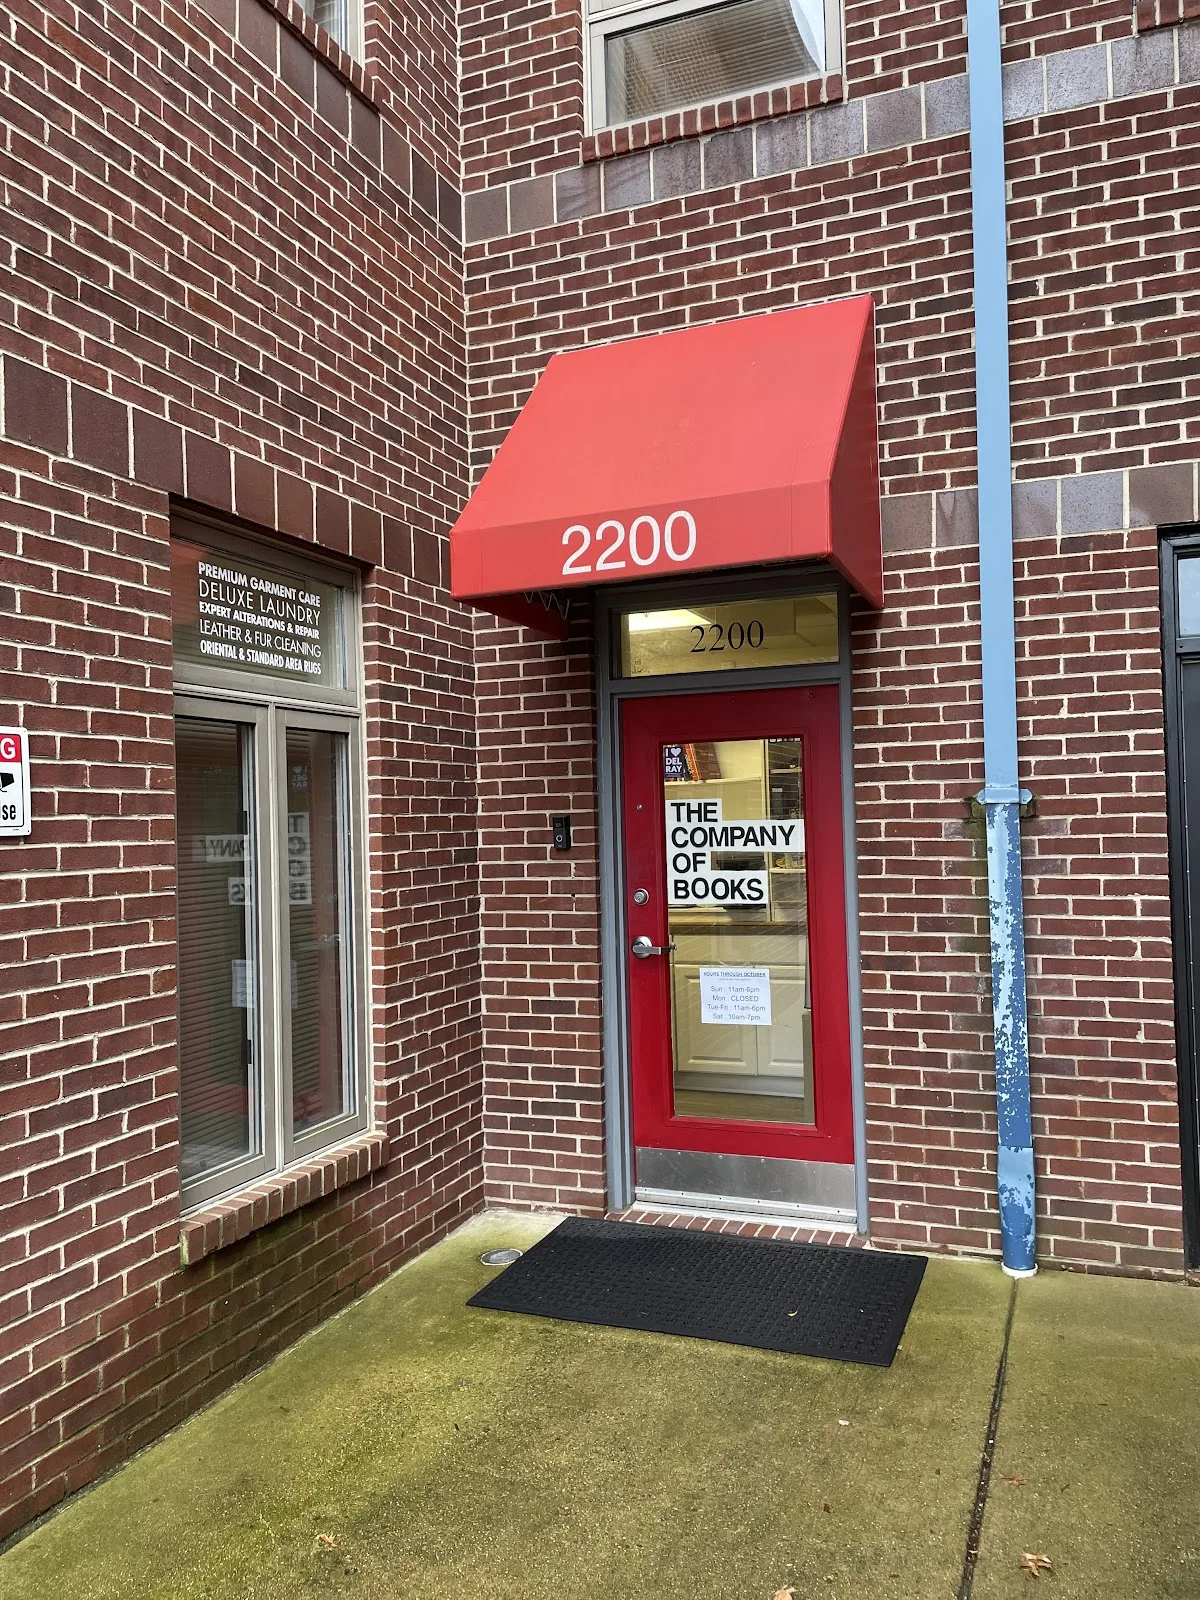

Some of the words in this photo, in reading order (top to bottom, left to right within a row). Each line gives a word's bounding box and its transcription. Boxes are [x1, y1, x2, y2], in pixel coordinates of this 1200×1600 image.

[562, 510, 697, 576] 2200
[198, 561, 249, 588] PREMIUM
[250, 576, 297, 601] GARMENT
[298, 591, 321, 608] CARE
[199, 578, 254, 610] DELUXE
[260, 595, 321, 626] LAUNDRY
[199, 601, 232, 619] EXPERT
[232, 609, 285, 632] ALTERATIONS
[287, 623, 294, 633] &
[295, 625, 320, 640] REPAIR
[690, 620, 764, 653] 2200
[200, 618, 242, 642] LEATHER
[244, 628, 253, 643] &
[255, 631, 273, 649] FUR
[274, 635, 322, 658] CLEANING
[200, 639, 238, 660] ORIENTAL
[239, 647, 245, 661] &
[247, 649, 284, 668] STANDARD
[285, 656, 303, 672] AREA
[303, 659, 322, 675] RUGS
[665, 757, 682, 766] DEL
[665, 765, 682, 773] RAY
[670, 802, 718, 823] THE
[671, 825, 796, 848] COMPANY
[672, 852, 706, 874] OF
[674, 878, 764, 900] BOOKS
